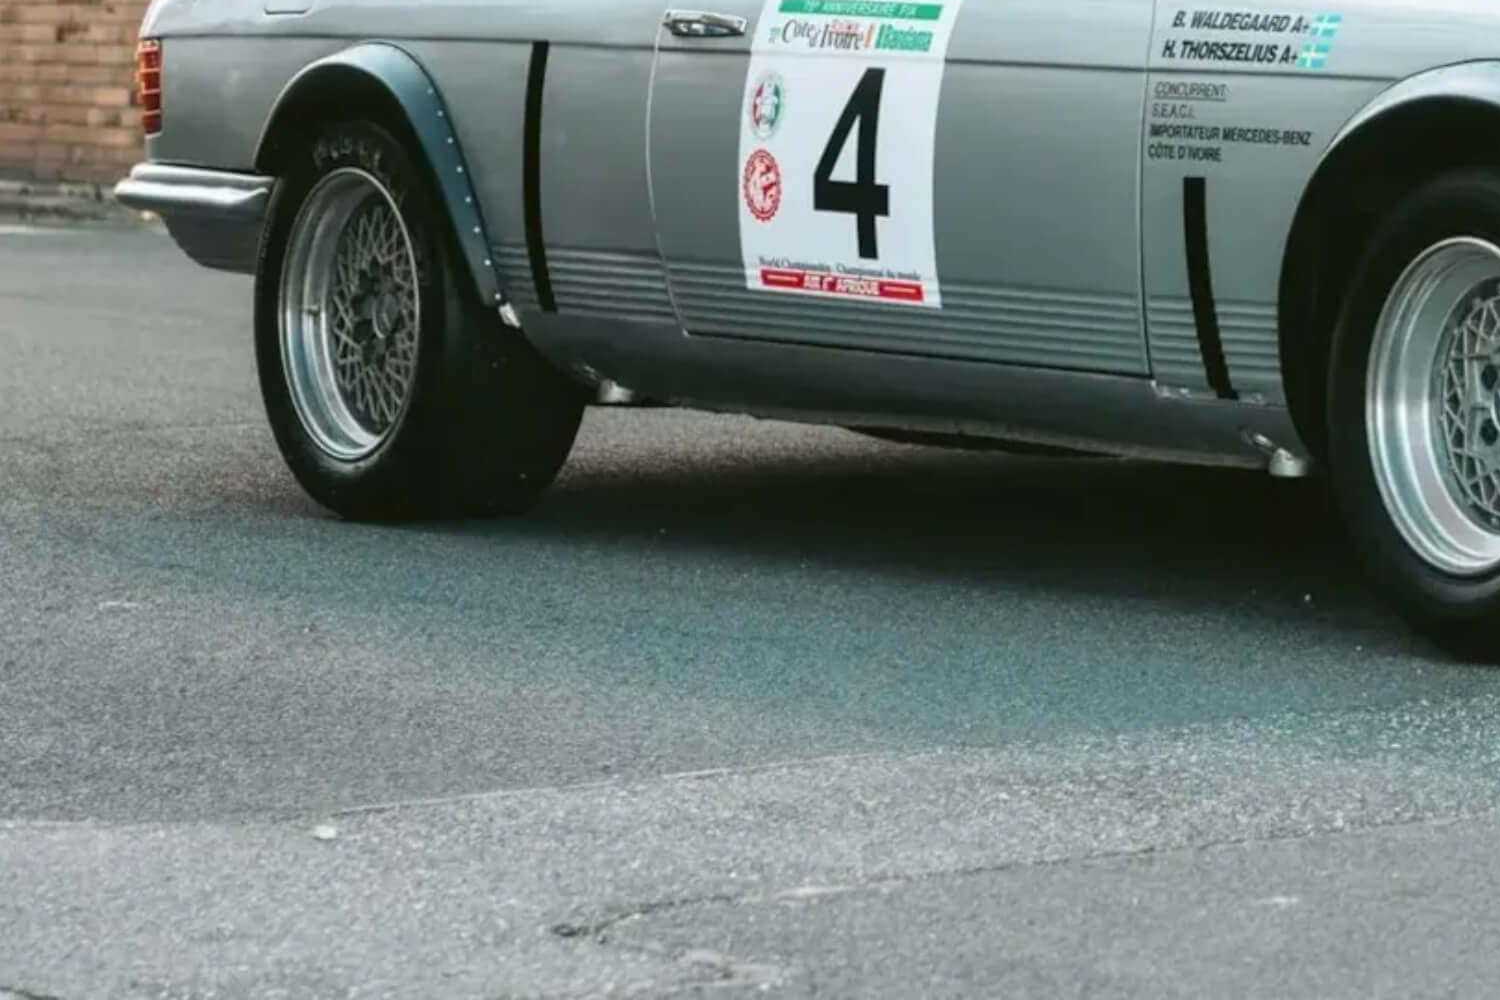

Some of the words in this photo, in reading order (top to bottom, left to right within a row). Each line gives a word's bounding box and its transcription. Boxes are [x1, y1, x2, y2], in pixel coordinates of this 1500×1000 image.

[1172, 10, 1186, 27] B.
[1190, 10, 1290, 32] WALDEGAARD
[1162, 40, 1176, 58] H.
[1179, 41, 1279, 63] THORSZELIUS
[1149, 123, 1220, 141] IMPORTATEUR
[1221, 127, 1313, 146] MERCEDES-BENZ
[1147, 141, 1176, 160] CÔTE
[812, 66, 890, 261] 4
